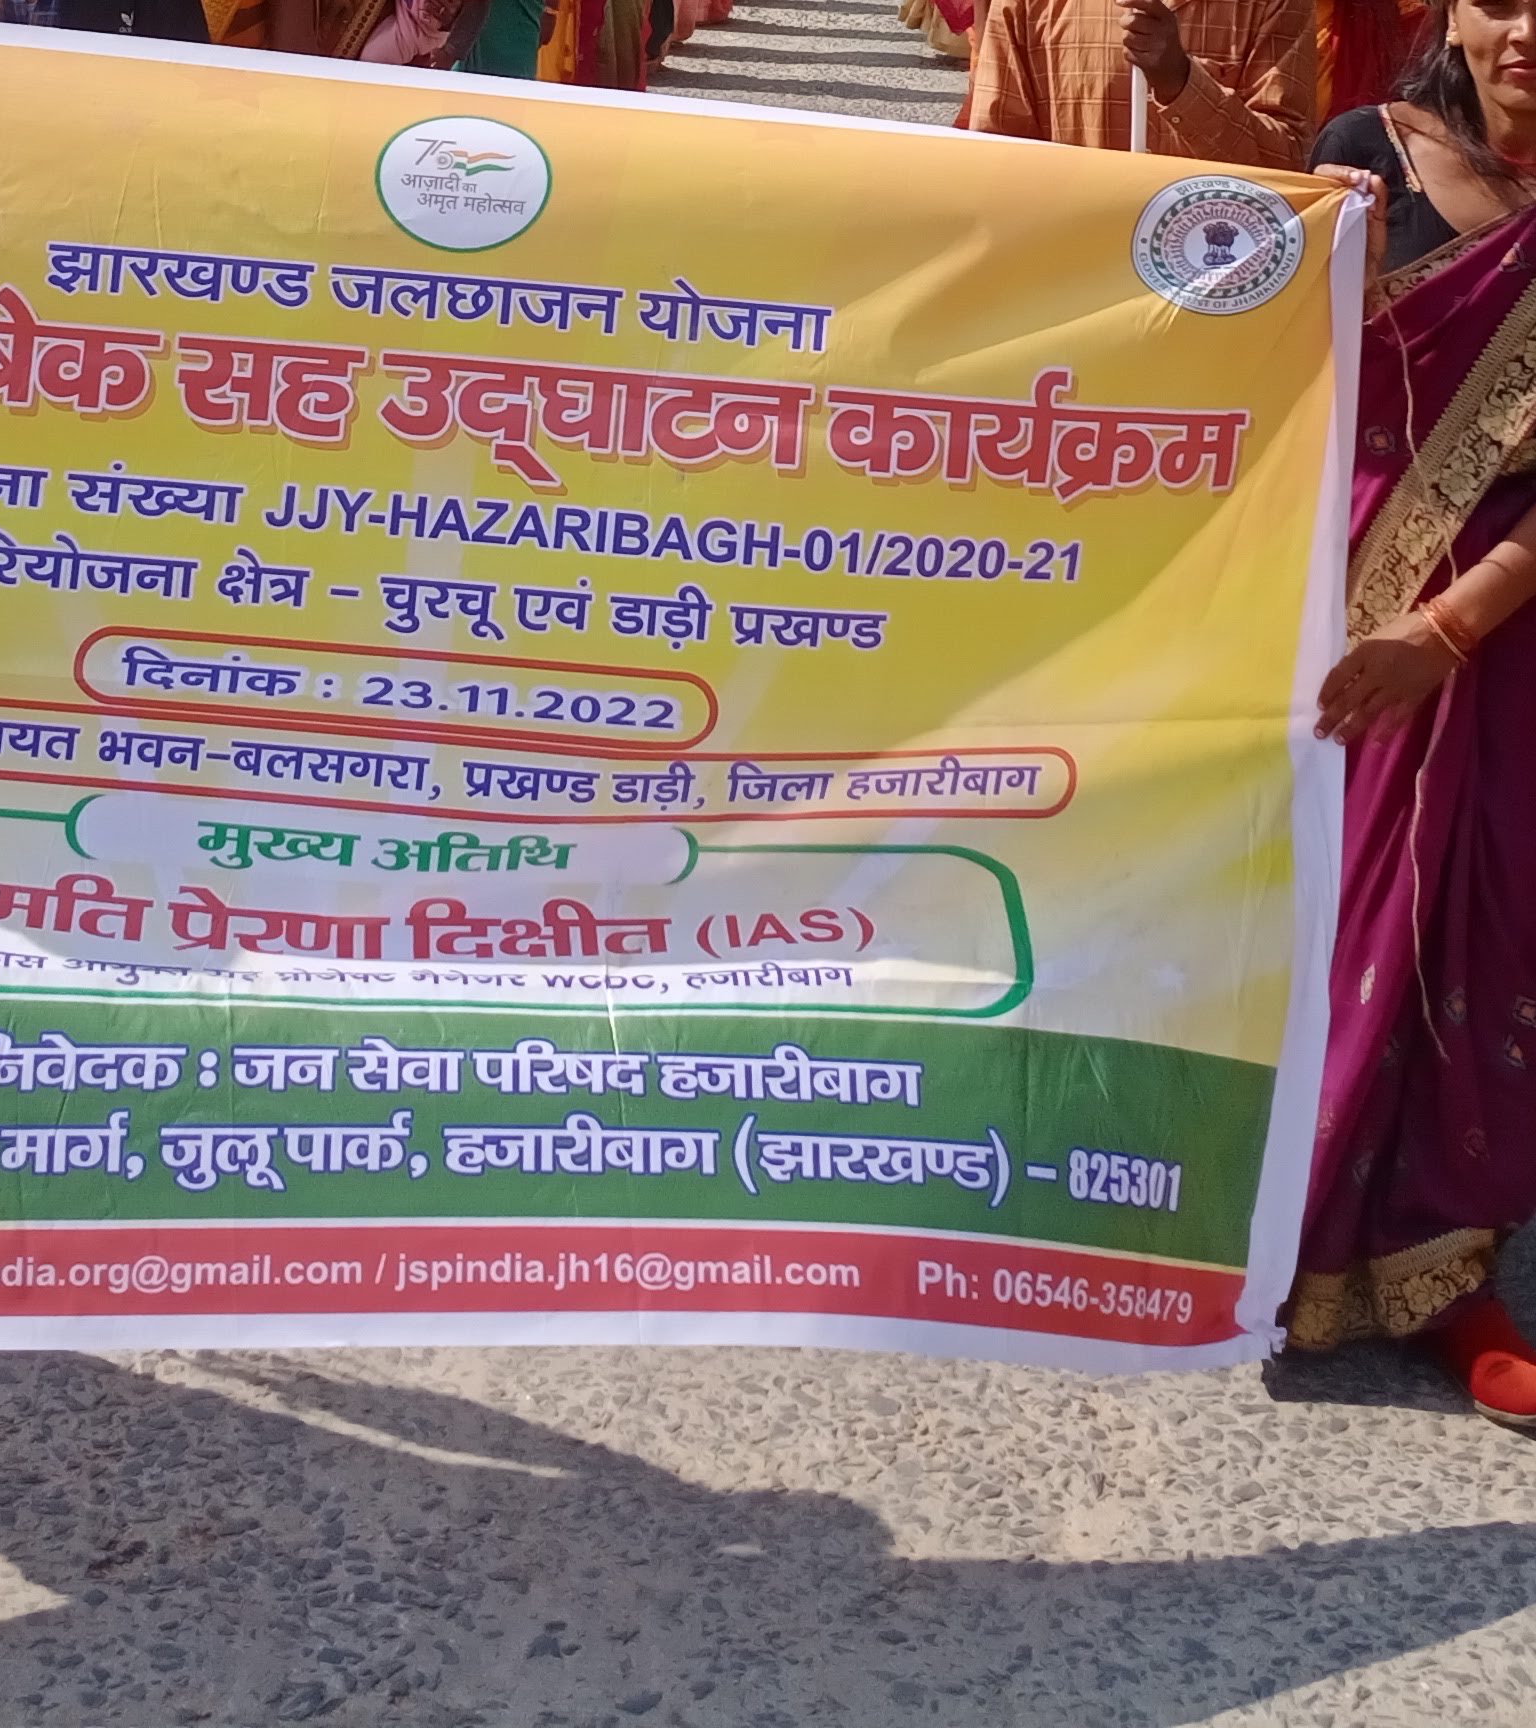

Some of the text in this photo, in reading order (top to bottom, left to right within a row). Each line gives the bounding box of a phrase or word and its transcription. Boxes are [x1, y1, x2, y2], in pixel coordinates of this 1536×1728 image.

[417, 192, 527, 215] अमृत महोत्सव
[462, 182, 477, 193] का
[46, 240, 833, 352] झारखण्ड जलछाजन योजना
[1213, 300, 1228, 309] OF
[1232, 252, 1296, 307] JHARKHAND
[176, 333, 364, 444] सह
[827, 366, 1250, 503] कार्यक्रम
[67, 459, 244, 525] संख्या
[265, 482, 1082, 584] JJY-HAZARIBAGH-01/2020-21
[217, 546, 311, 607] क्षेत्र
[380, 574, 507, 641] चुरचू
[513, 578, 594, 632] एवं
[609, 584, 714, 651] डाड़ी
[729, 603, 888, 649] प्रखण्ड
[122, 646, 301, 697] दिनांक
[362, 676, 676, 729] 23.11.2022
[462, 758, 599, 804] प्रखण्ड
[727, 758, 830, 805] जिला
[846, 755, 1042, 802] हजारीबाग
[197, 820, 577, 873] मुख्य अतिथि
[167, 885, 391, 961] प्रेरणा
[405, 896, 673, 960] दिक्षीत
[695, 906, 876, 959] (IAS)
[230, 1044, 340, 1095] जन
[348, 1036, 465, 1096] सेवा
[473, 1038, 649, 1097] परिषद
[658, 1043, 923, 1108] हजारीबाग
[0, 1110, 144, 1182] मार्ग,
[161, 1125, 286, 1191] जुलू
[284, 1109, 428, 1182] पार्क,
[443, 1113, 720, 1180] हजारीबाग
[732, 1115, 1011, 1209] (झारखण्ड)
[1067, 1149, 1183, 1214] 825301
[395, 1252, 861, 1292] jspindia.jh16@gmail.com
[917, 1260, 980, 1301] Ph:
[992, 1268, 1194, 1325] 06546-358479
